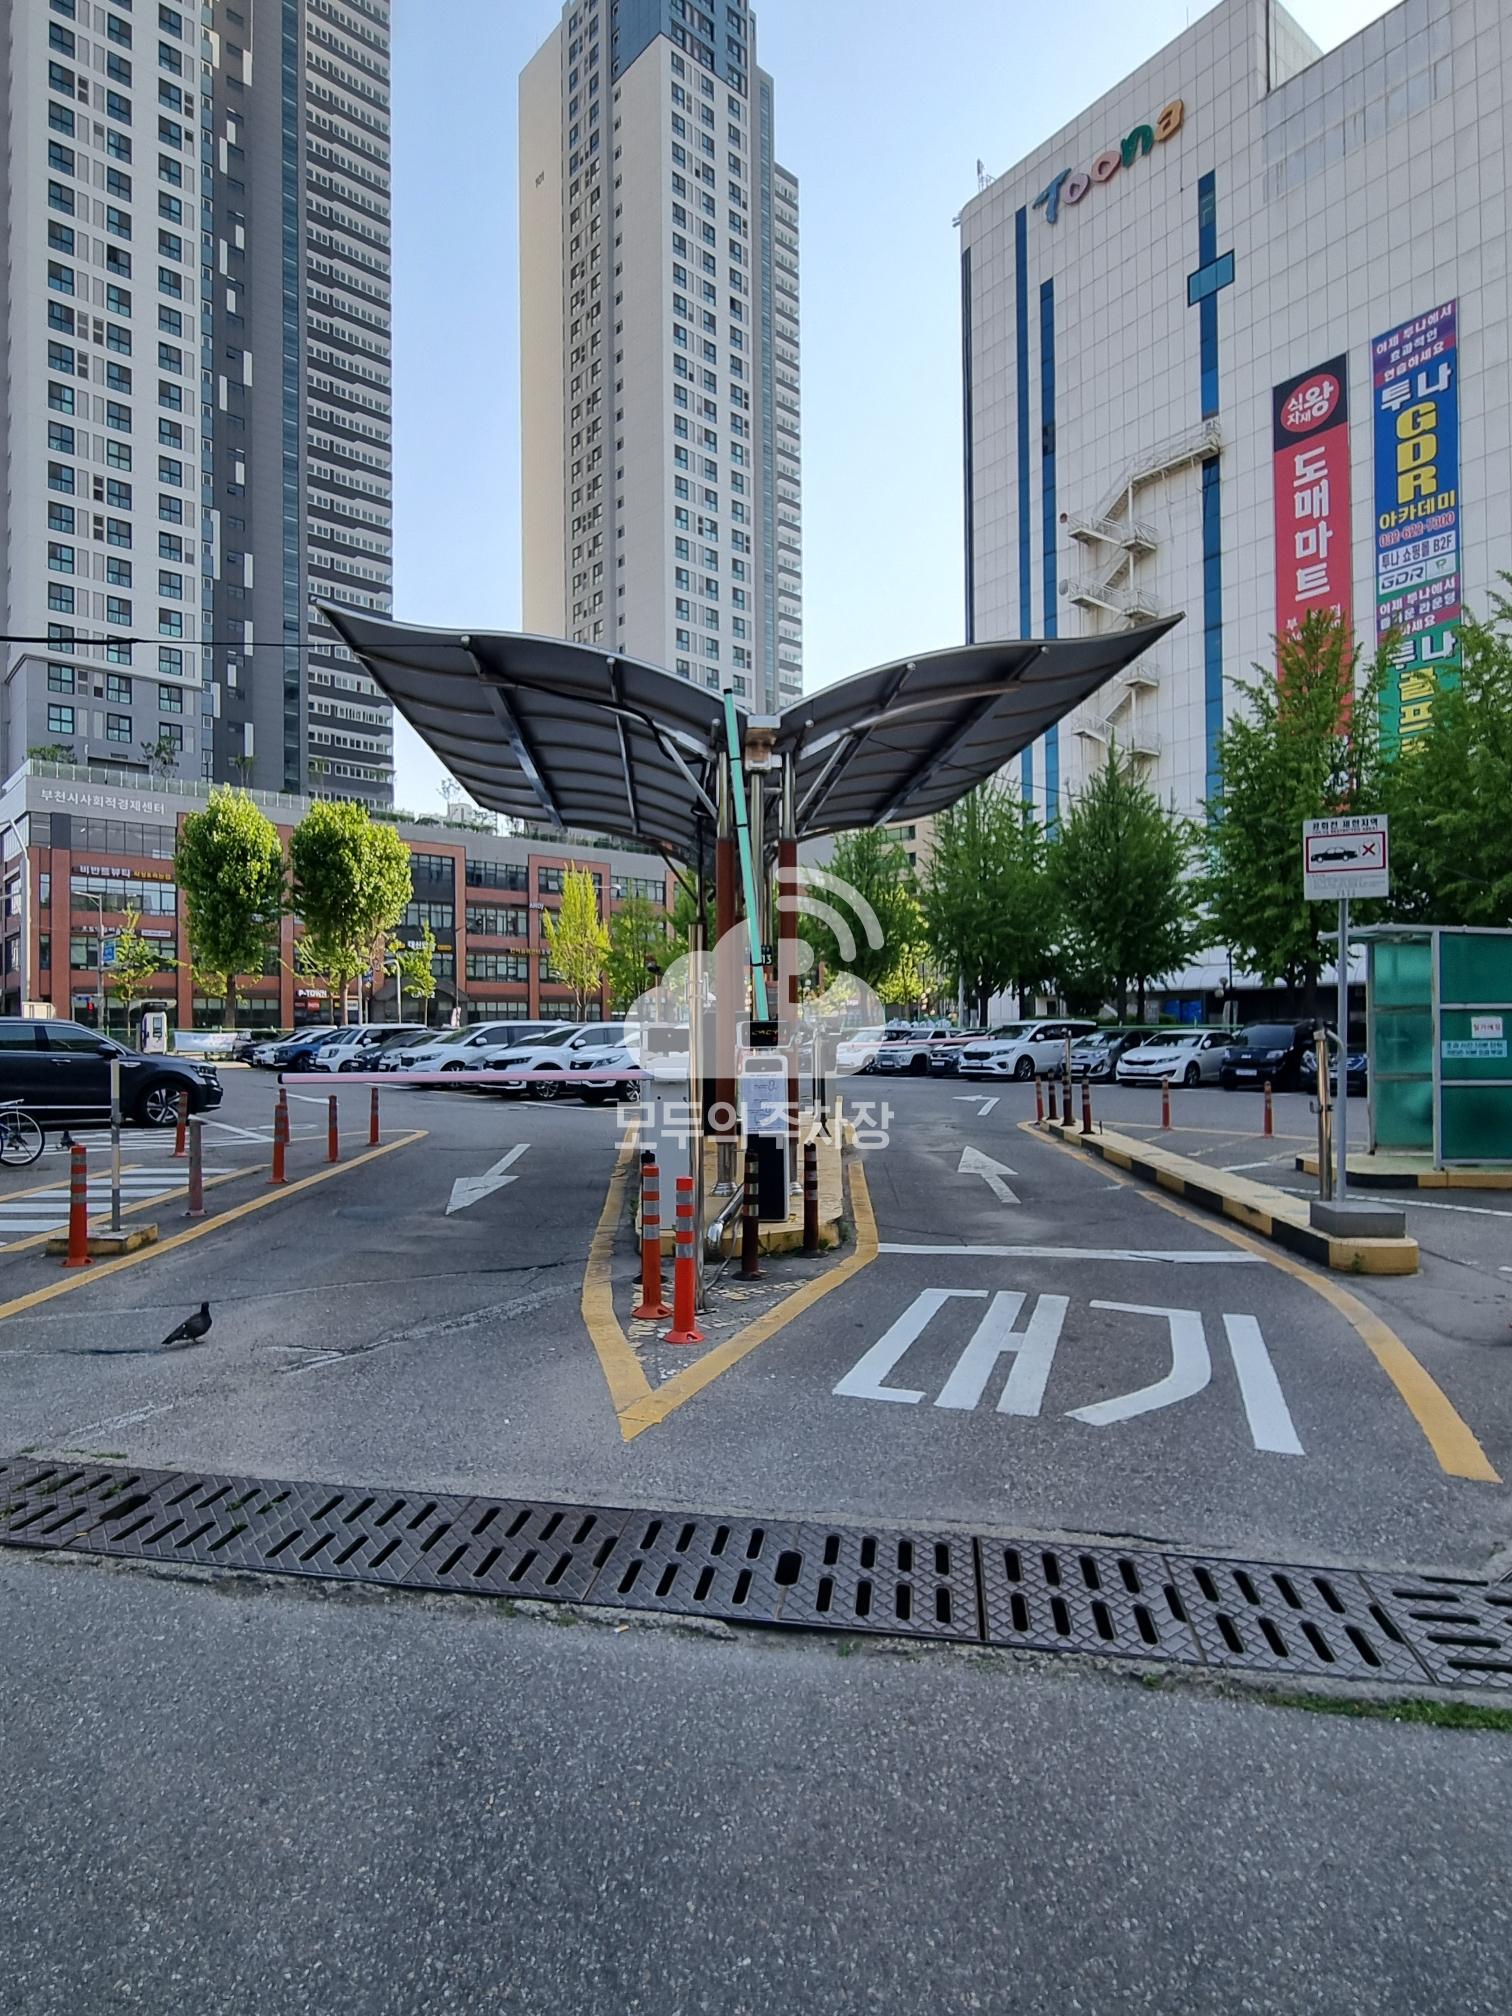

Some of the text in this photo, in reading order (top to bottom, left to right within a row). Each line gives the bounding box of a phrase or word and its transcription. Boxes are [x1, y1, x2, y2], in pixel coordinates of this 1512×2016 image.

[1032, 98, 1184, 224] Toona
[1376, 303, 1452, 354] 이제 투나에서
[1390, 328, 1438, 363] 효과적인
[1384, 341, 1445, 382] 연습하세요
[1381, 362, 1452, 411] 투나
[1396, 401, 1436, 504] GDR
[1294, 446, 1333, 601] 도매마트
[1379, 491, 1455, 529] 아카데미
[1382, 534, 1452, 569] 투나 쇼핑몰 B2F
[1380, 576, 1455, 615] 이제 투나에서
[1381, 566, 1423, 590] GDR
[1419, 591, 1456, 614] 라운딩
[1386, 631, 1457, 671] 투나
[40, 789, 165, 814] 부천시사회적경제센터
[298, 989, 327, 998] P-TOWN
[832, 1288, 1305, 1456] 대기
